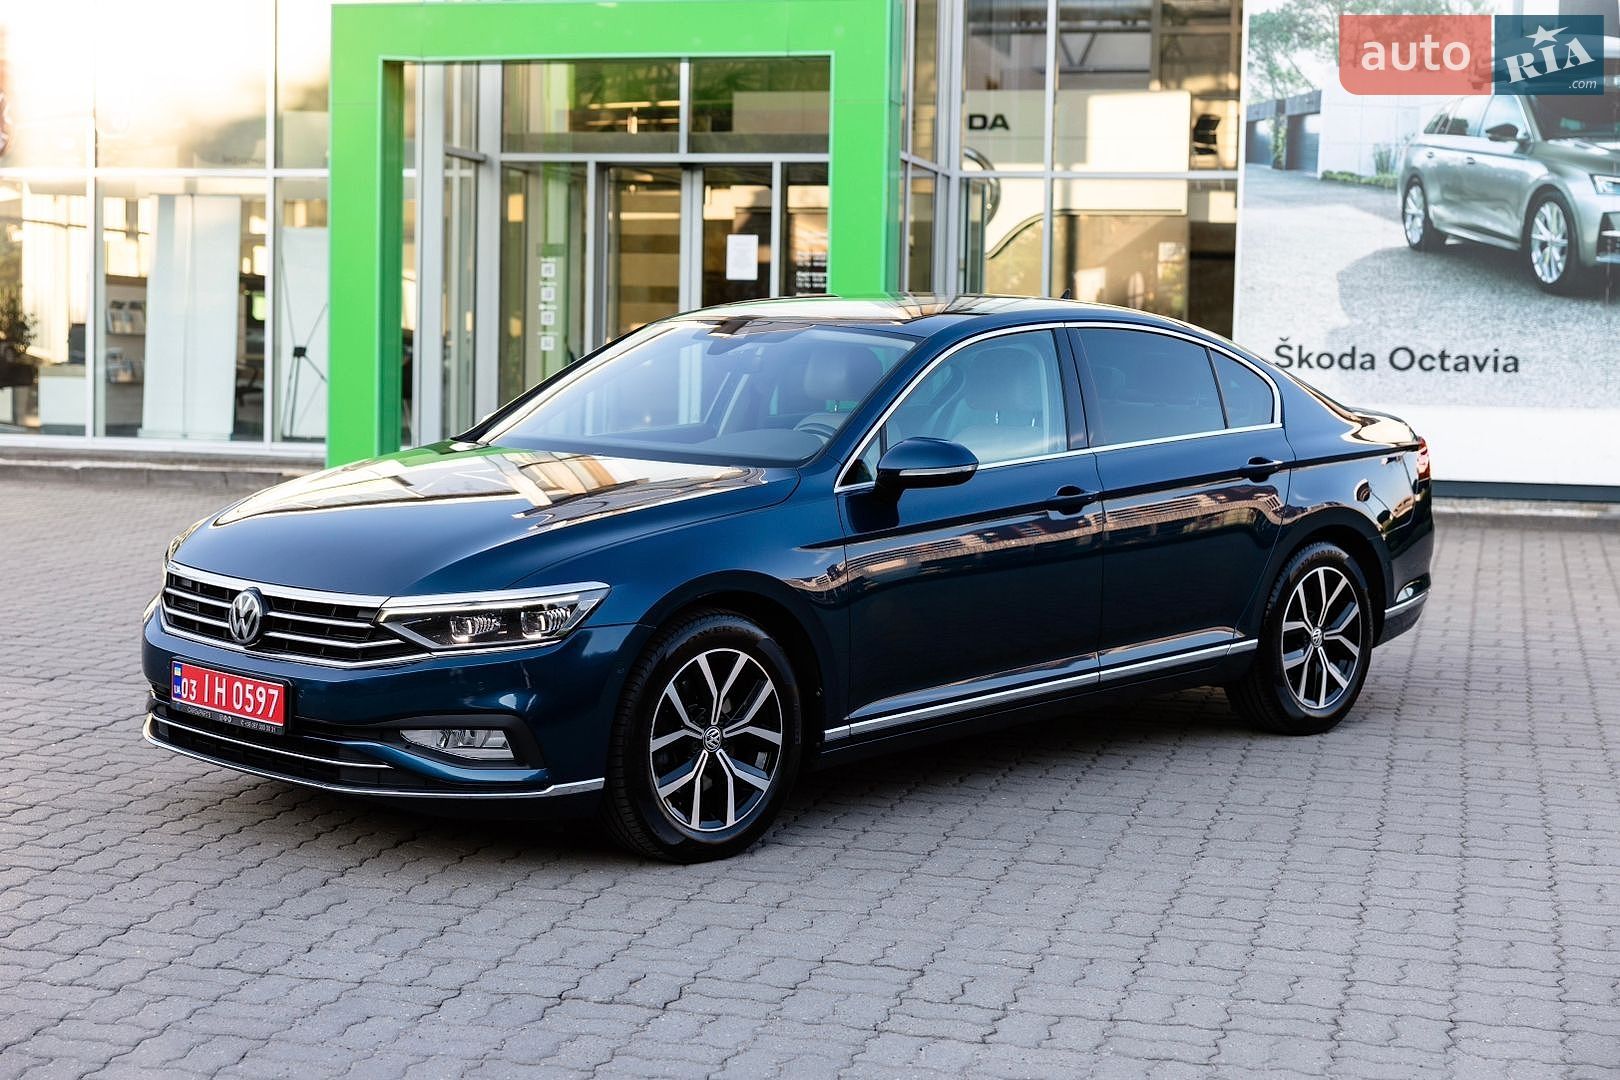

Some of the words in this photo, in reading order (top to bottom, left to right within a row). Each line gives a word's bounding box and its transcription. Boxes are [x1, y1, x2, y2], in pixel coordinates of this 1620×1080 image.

[969, 114, 1009, 130] DA
[1274, 336, 1376, 371] Škoda
[1388, 346, 1520, 373] Octavia
[181, 677, 197, 700] 03
[232, 681, 279, 718] 0597
